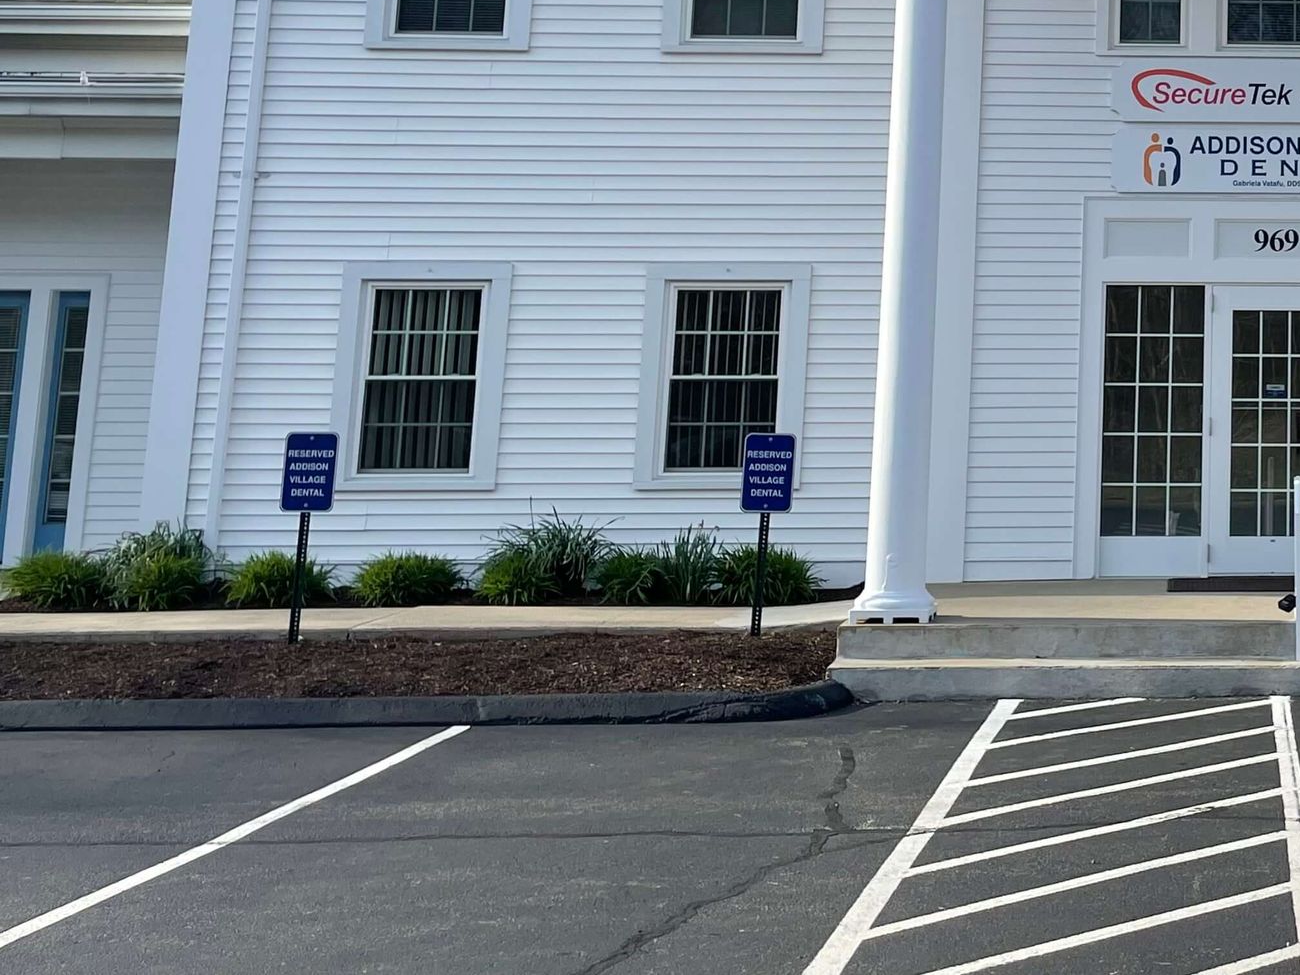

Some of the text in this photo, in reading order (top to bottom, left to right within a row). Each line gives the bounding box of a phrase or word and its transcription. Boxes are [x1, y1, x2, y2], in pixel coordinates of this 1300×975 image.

[1152, 82, 1293, 106] SecureTek
[1232, 179, 1261, 187] Gabriela
[1253, 228, 1300, 252] 969
[288, 449, 335, 458] RESERVED
[747, 450, 793, 459] RESERVED
[289, 462, 329, 471] ADDISON
[748, 463, 787, 472] ADDISON
[289, 475, 327, 484] VILLAGE
[748, 476, 785, 485] VILLAGE
[290, 488, 325, 497] DENTAL
[750, 489, 784, 497] DENTAL
